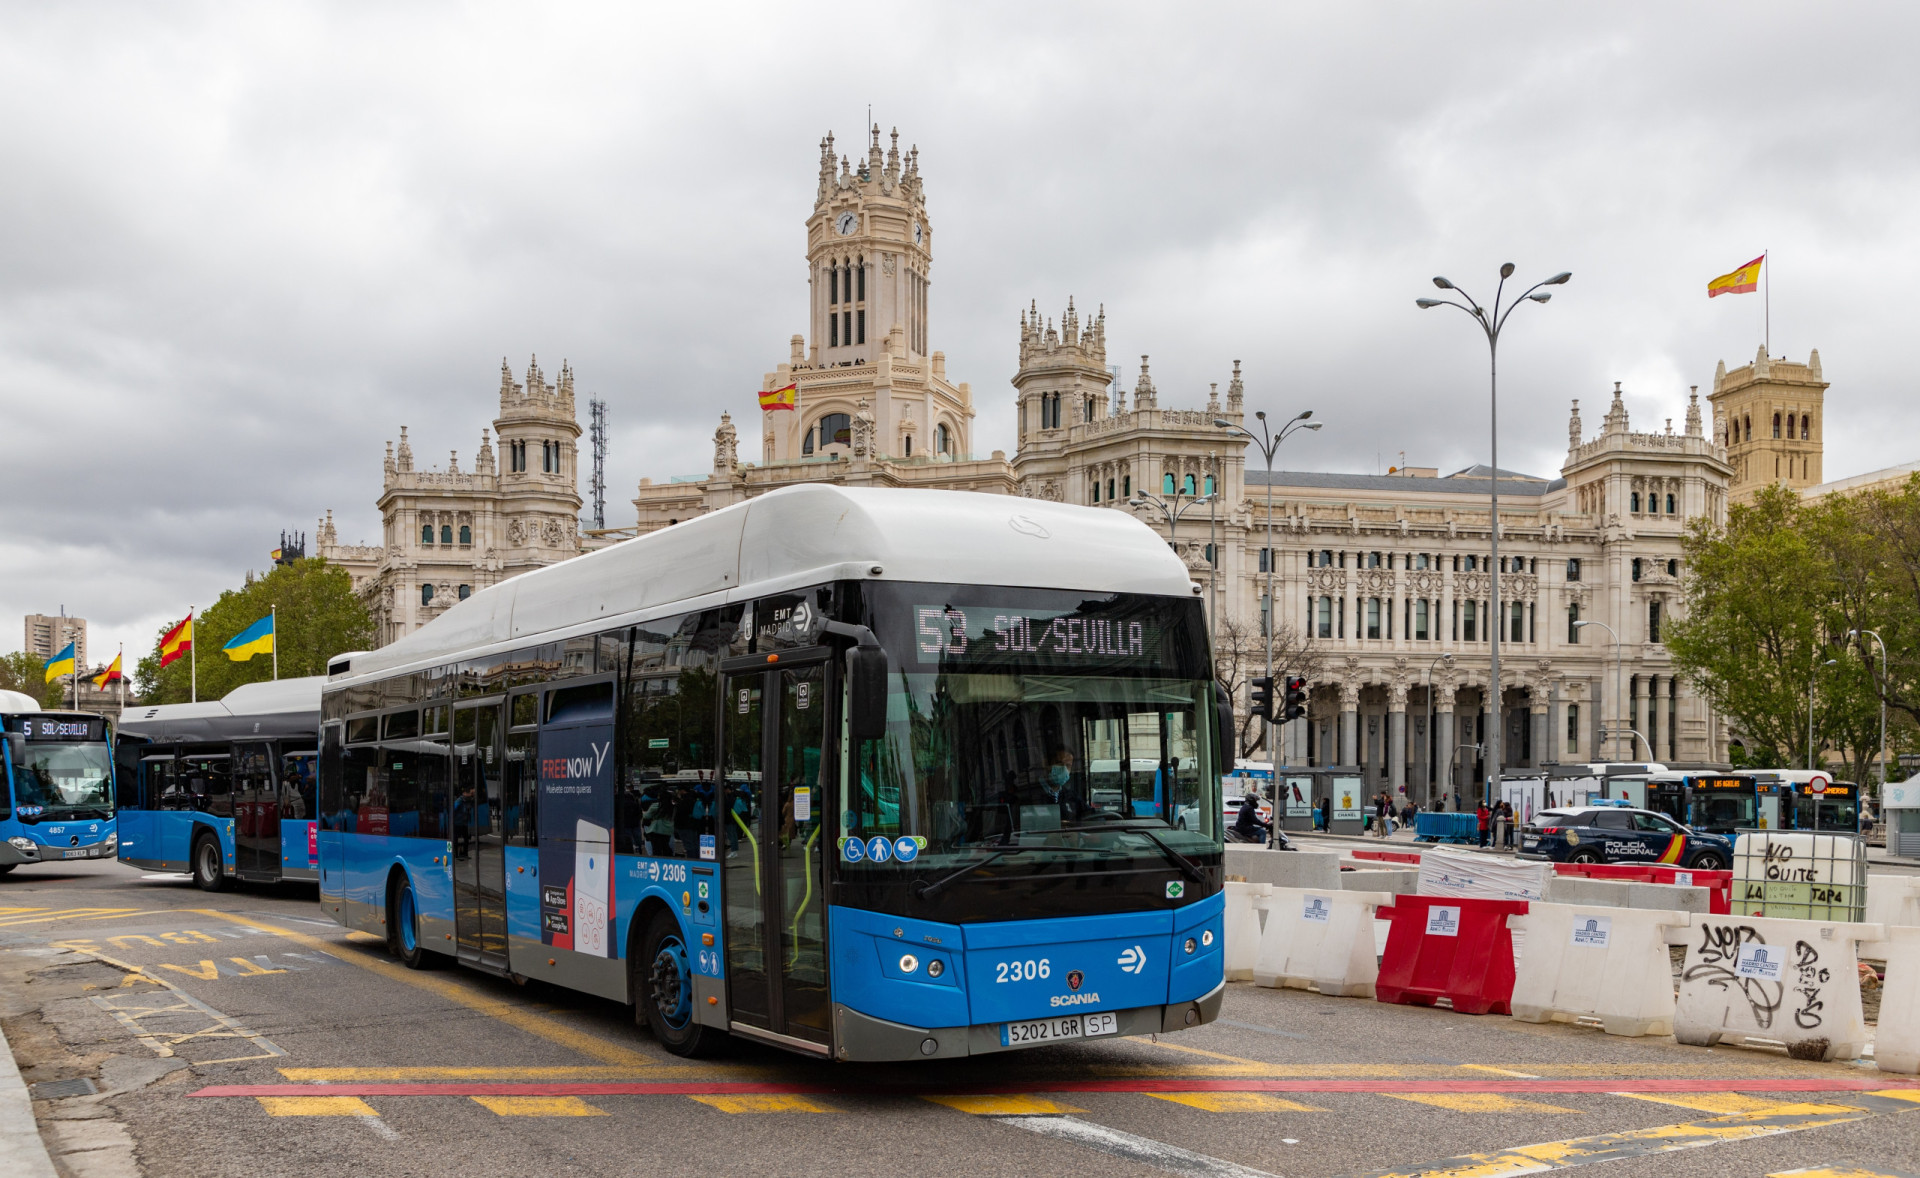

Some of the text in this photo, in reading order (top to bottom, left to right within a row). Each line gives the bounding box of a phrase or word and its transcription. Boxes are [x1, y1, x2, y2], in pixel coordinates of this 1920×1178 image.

[774, 607, 792, 620] EMT
[760, 621, 791, 635] MADRID
[919, 609, 1142, 655] 53 SOL/SEVILLA
[23, 721, 88, 736] 5 SOL/SEVILLA
[564, 786, 575, 794] como
[1698, 780, 1706, 788] 34
[48, 826, 65, 834] 4857
[1605, 840, 1646, 849] POLICÍA
[1605, 848, 1658, 856] NACIONAL
[1762, 842, 1793, 864] NO
[637, 861, 648, 869] EMT
[629, 870, 648, 879] MADRID
[662, 864, 686, 882] 2306
[1767, 864, 1819, 882] QUITE
[1747, 884, 1763, 900] LA
[1811, 887, 1842, 904] TAPA
[996, 958, 1050, 983] 2306
[1050, 993, 1100, 1007] SCANIA
[1011, 1019, 1079, 1041] 5202 LGR
[1089, 1015, 1112, 1033] SP
